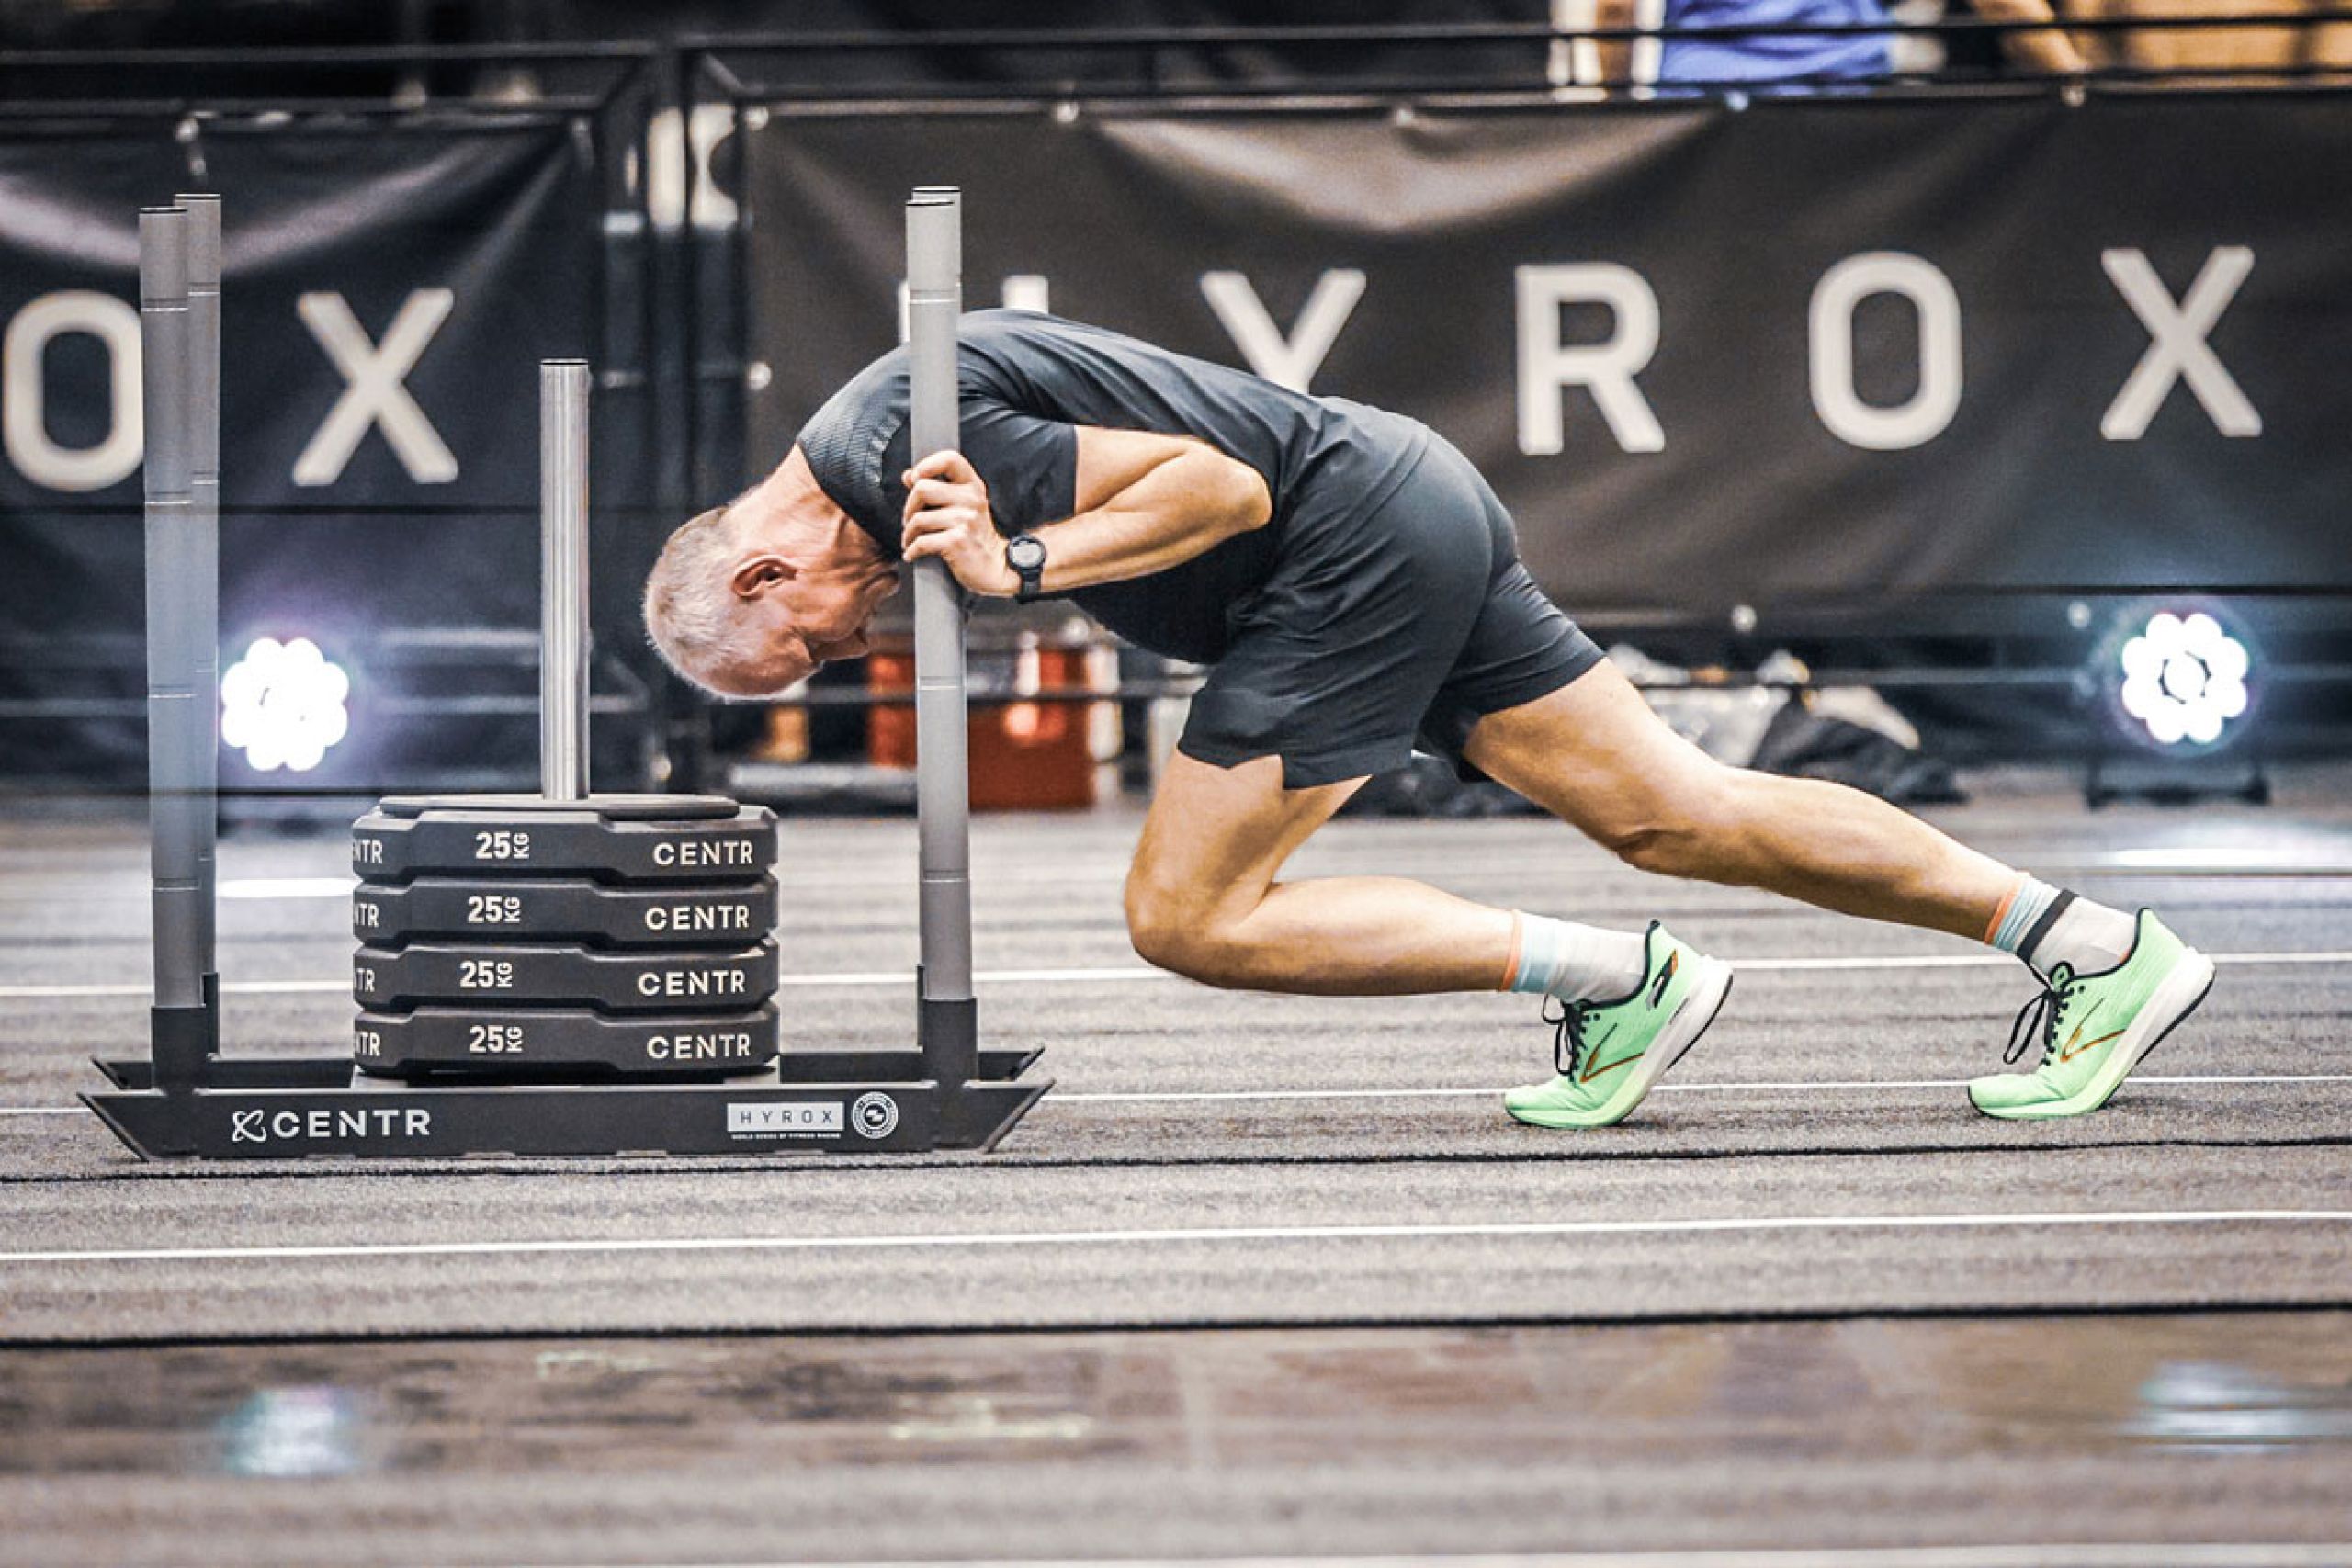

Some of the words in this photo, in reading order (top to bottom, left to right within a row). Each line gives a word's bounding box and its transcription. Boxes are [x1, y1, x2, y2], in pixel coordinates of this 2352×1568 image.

[898, 245, 2263, 455] YROX
[653, 841, 753, 865] CENTR
[644, 905, 750, 931] CENTR
[638, 970, 745, 996] CENTR
[646, 1034, 750, 1059] CENTR
[272, 1109, 430, 1138] CENTR
[741, 1111, 832, 1124] HYROX
